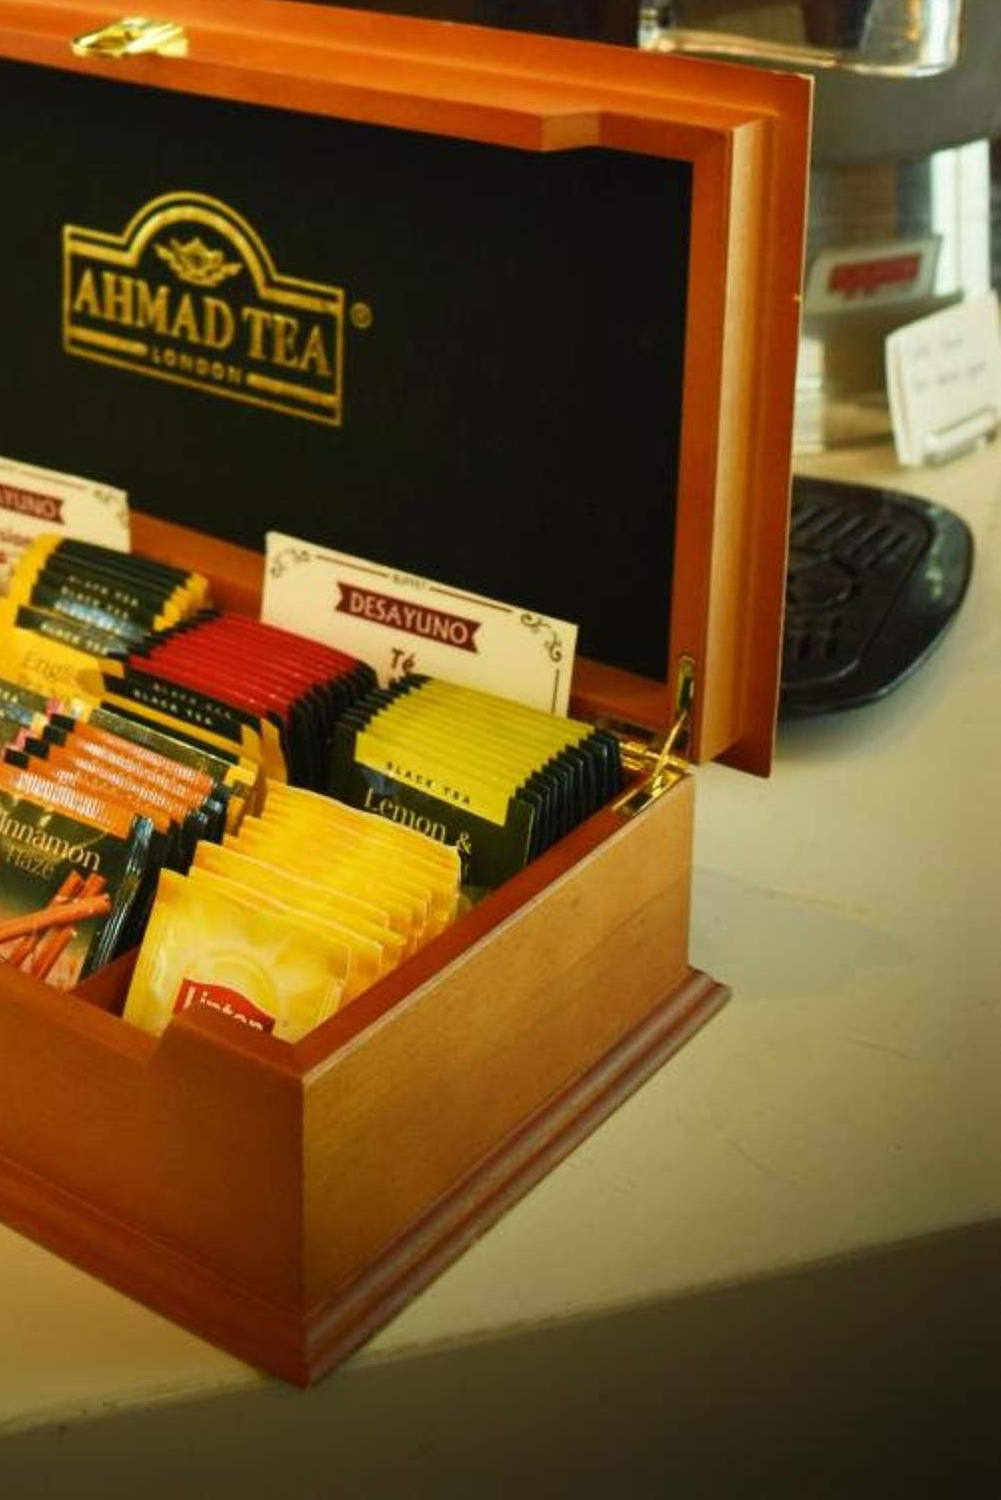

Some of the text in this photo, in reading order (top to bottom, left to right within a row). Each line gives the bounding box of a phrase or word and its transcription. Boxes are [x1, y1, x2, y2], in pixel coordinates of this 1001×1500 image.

[73, 267, 332, 377] AHMAD TEA
[151, 347, 243, 385] LONDON
[350, 591, 468, 645] DESAYUNO
[390, 647, 415, 674] Té
[133, 689, 212, 726] BLACK TEA
[386, 760, 471, 805] BLACK TEA
[363, 787, 472, 855] Lemon &
[6, 846, 56, 878] Haze
